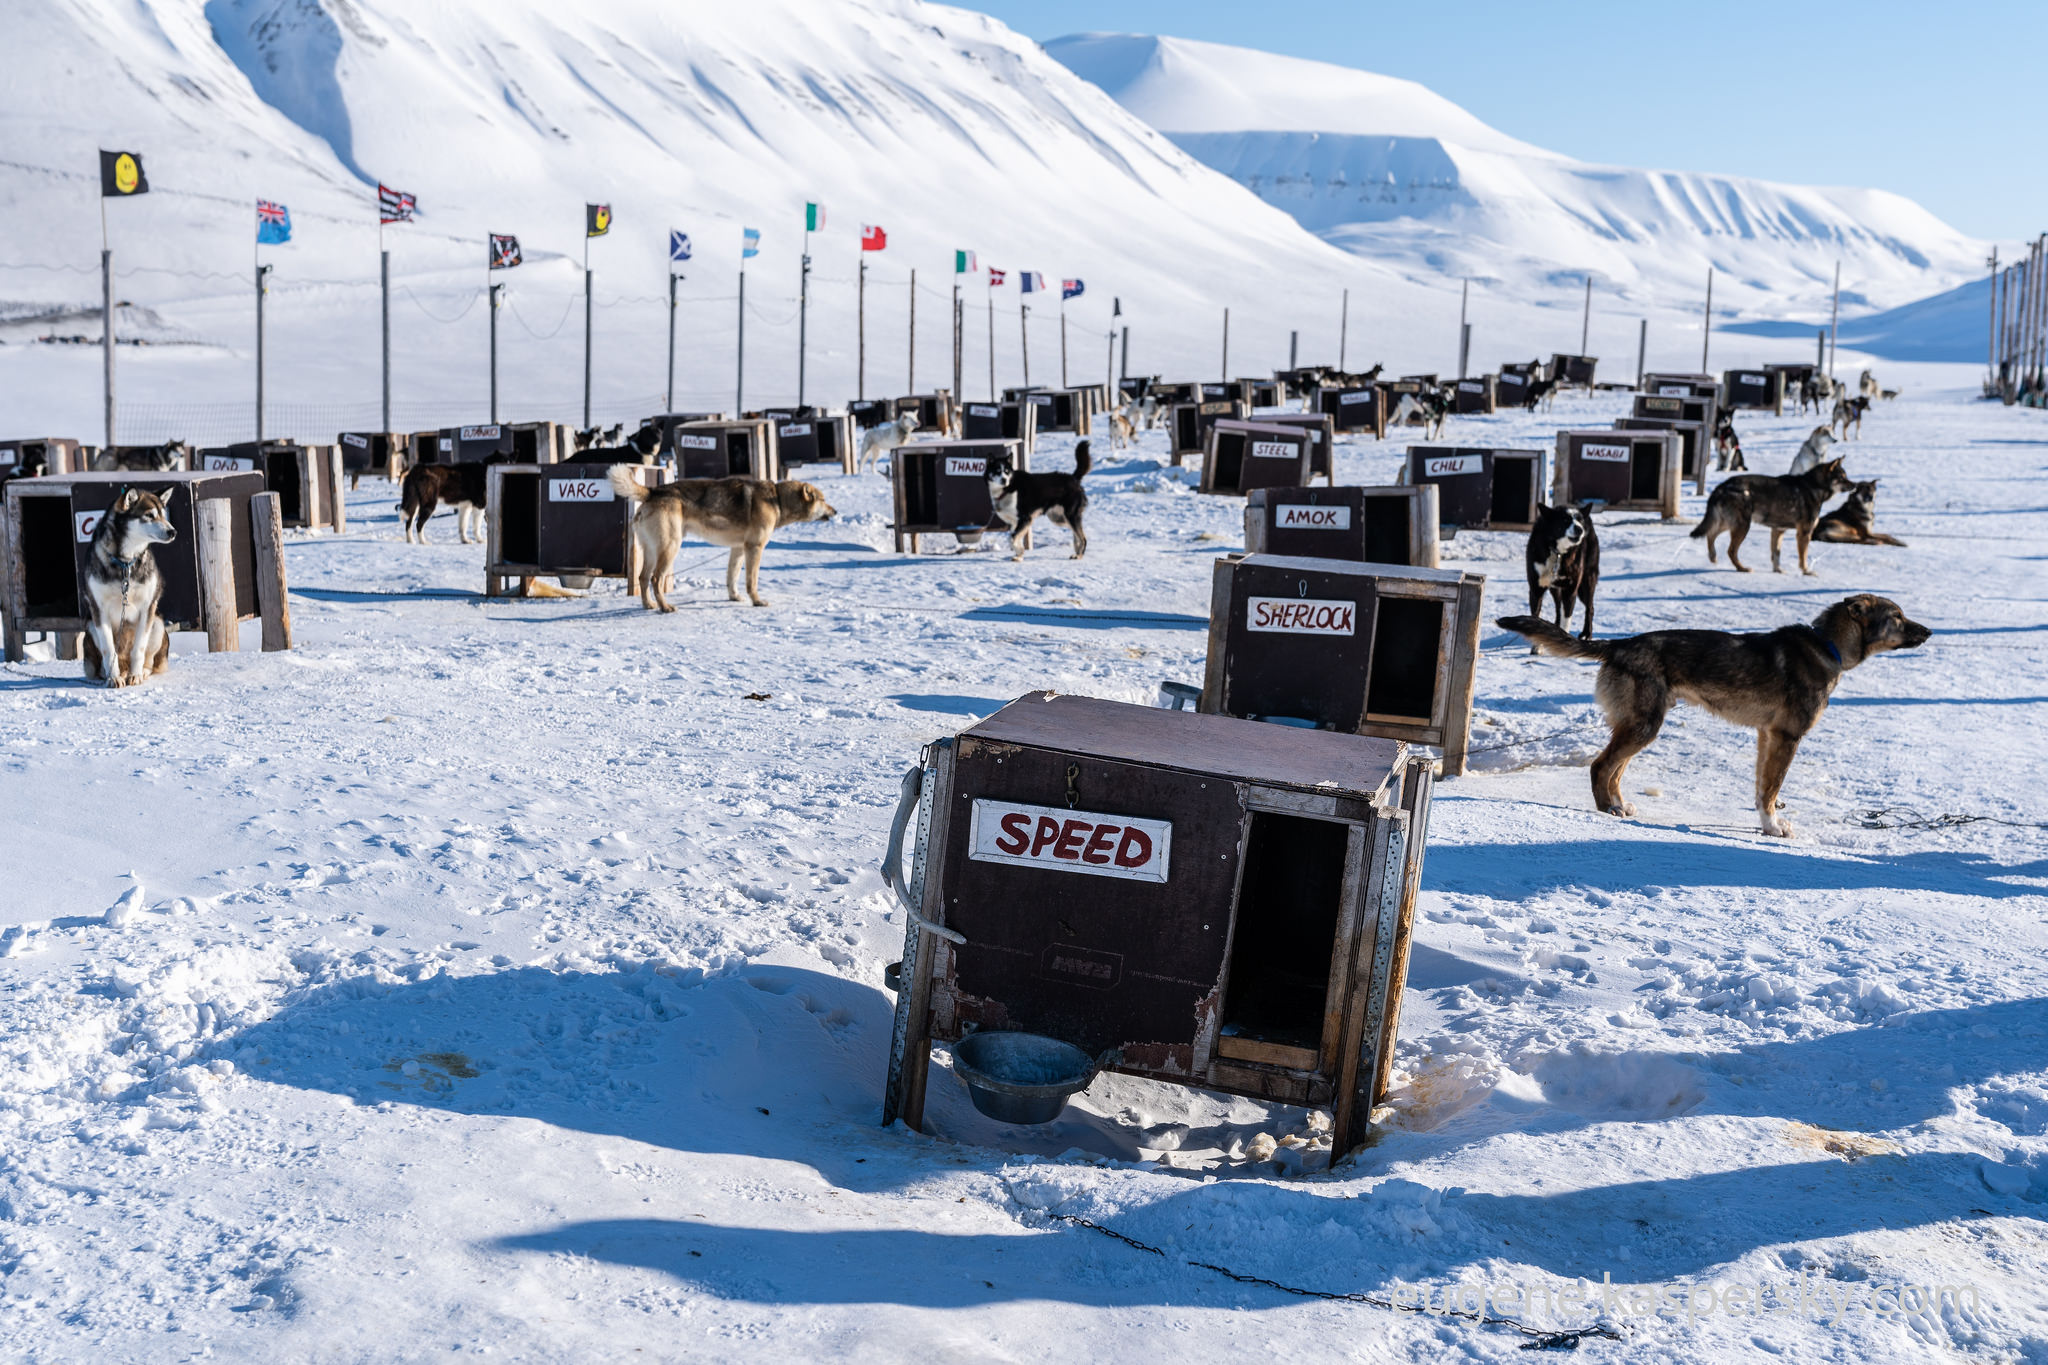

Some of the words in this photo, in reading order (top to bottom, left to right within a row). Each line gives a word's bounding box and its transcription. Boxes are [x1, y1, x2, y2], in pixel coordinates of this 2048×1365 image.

[1256, 444, 1288, 456] STEEL
[951, 460, 986, 473] THAND
[1431, 460, 1464, 473] CHILI
[558, 482, 600, 498] VARG
[1285, 510, 1337, 525] AMOK
[1254, 602, 1352, 632] SHERLOCK
[996, 812, 1152, 868] SPEED
